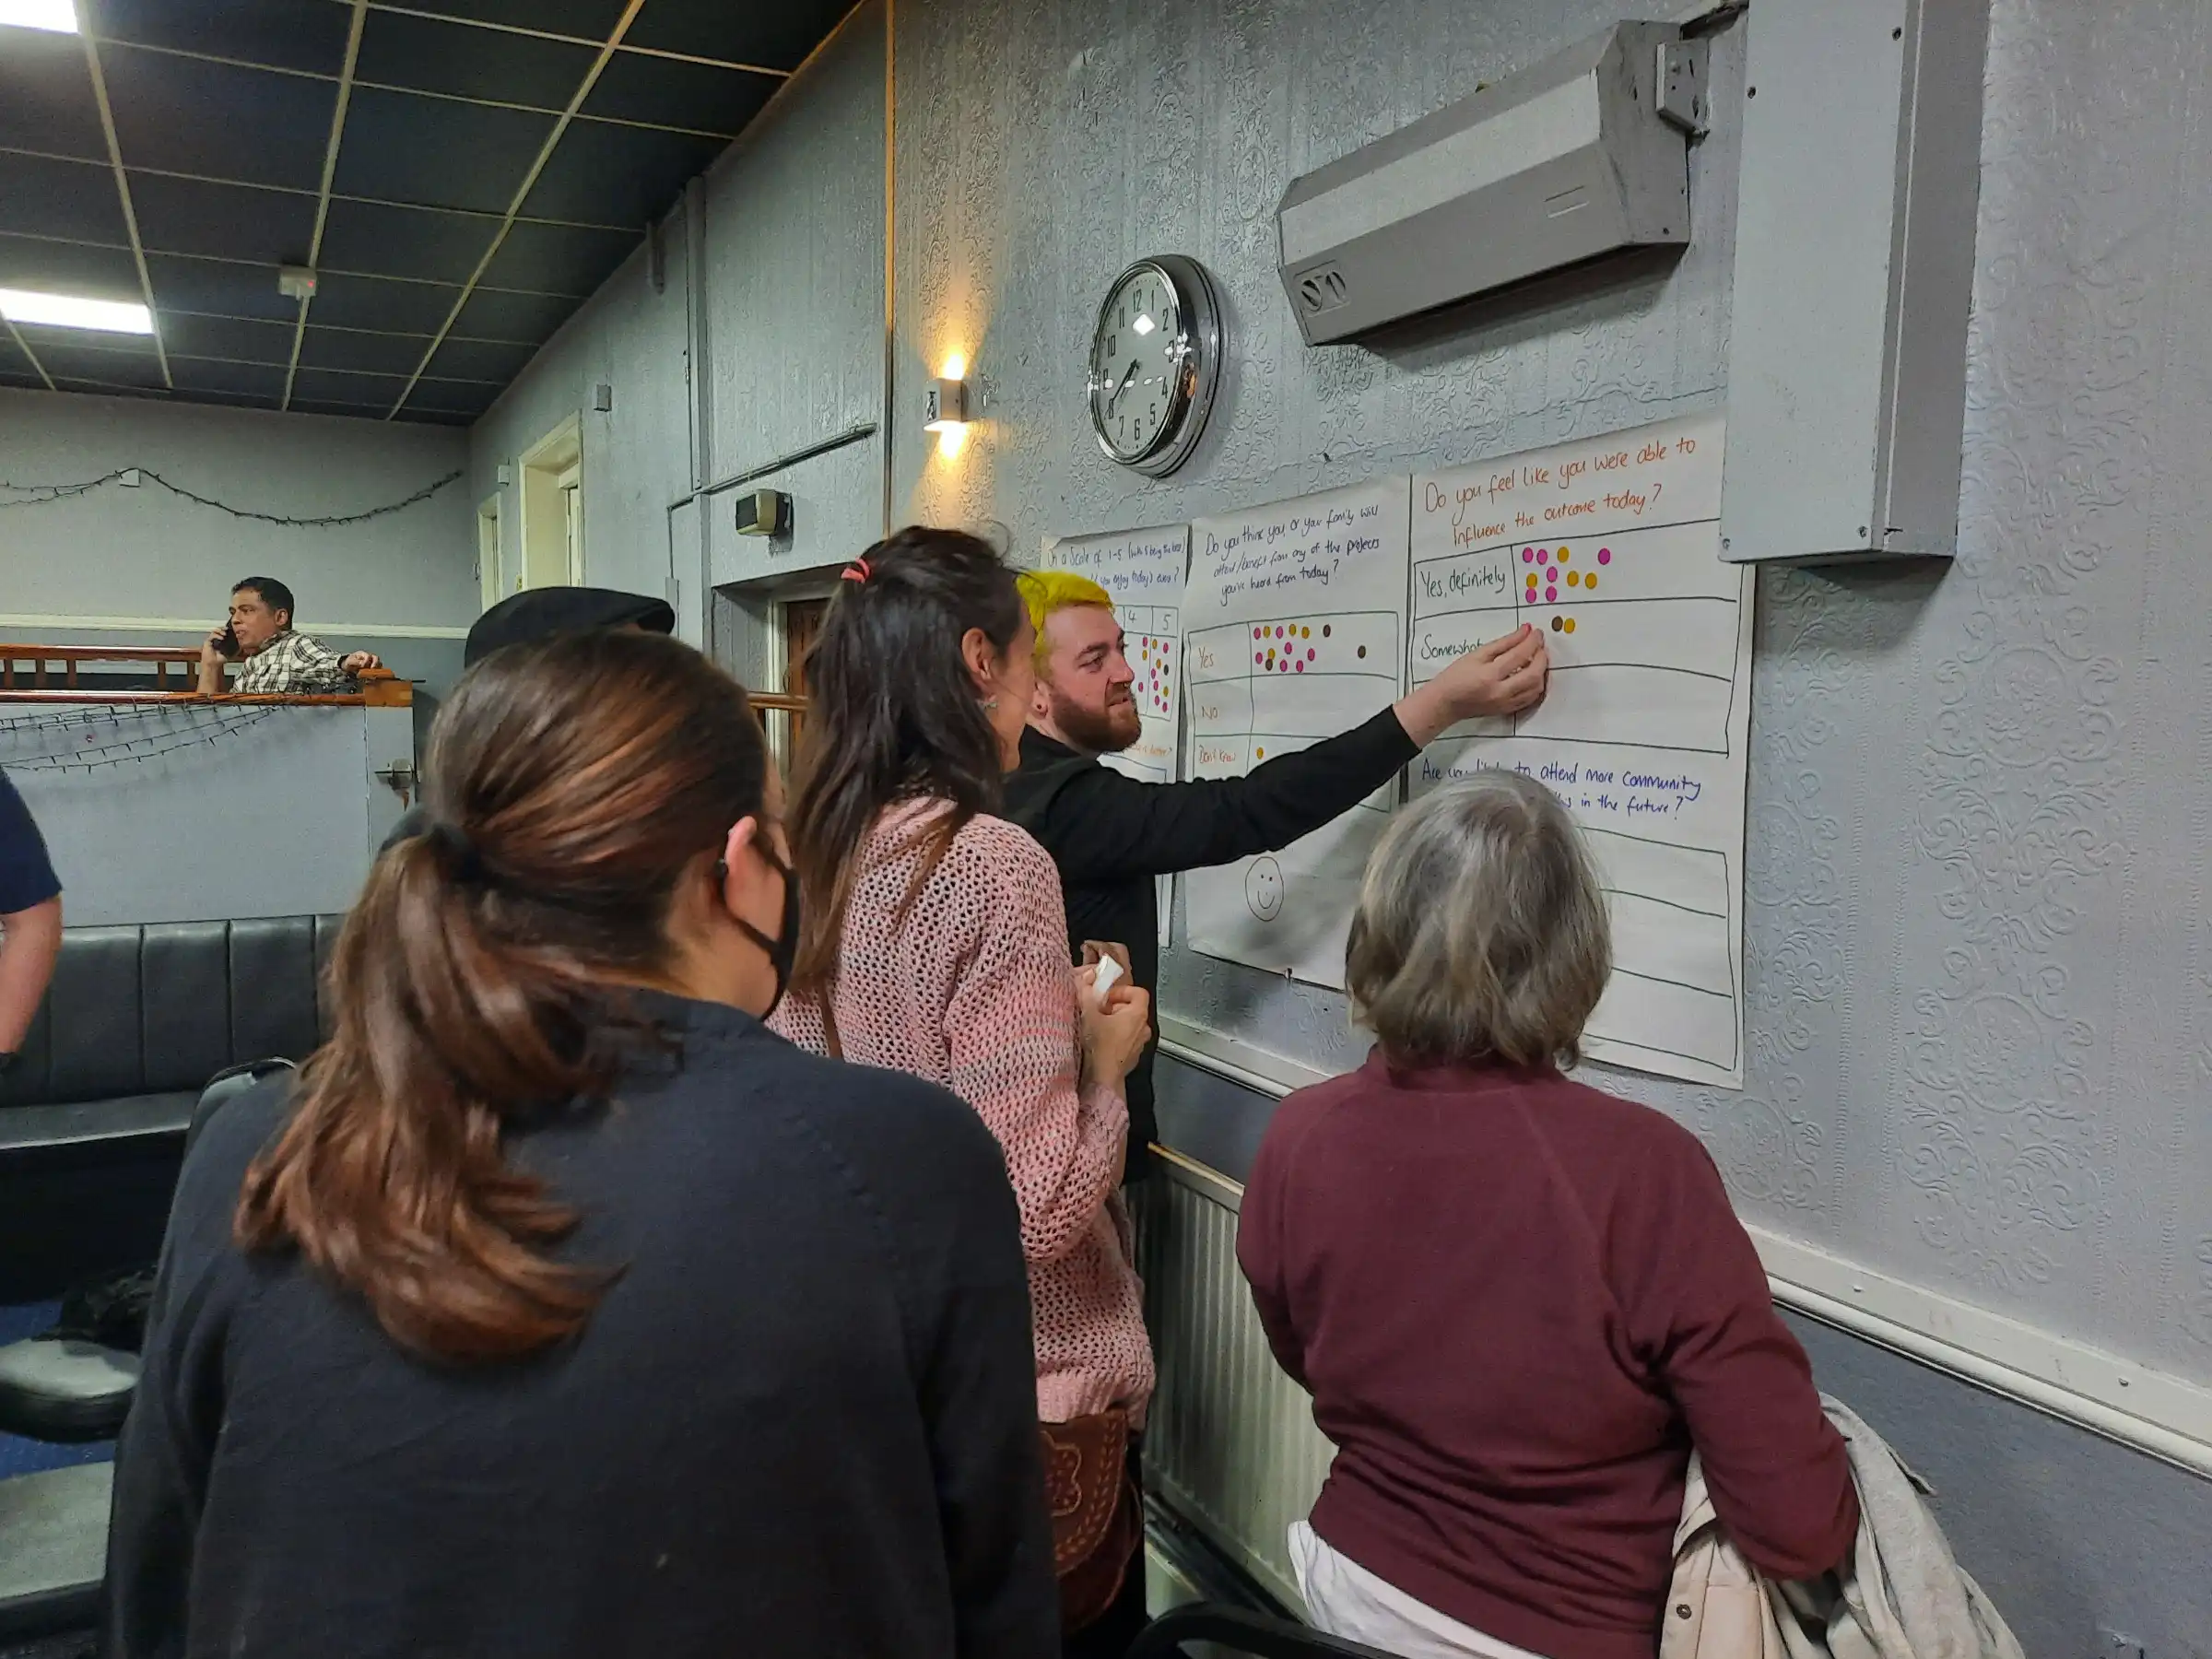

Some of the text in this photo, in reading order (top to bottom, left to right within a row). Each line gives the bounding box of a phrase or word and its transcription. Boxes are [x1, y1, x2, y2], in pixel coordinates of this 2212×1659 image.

[1133, 288, 1143, 312] 12
[1151, 288, 1155, 312] 1
[1118, 306, 1125, 329] 11
[1162, 308, 1169, 332] 2
[1107, 335, 1116, 358] 10
[1161, 376, 1168, 399] 4
[1108, 398, 1114, 420] 8
[1149, 402, 1156, 426] 5
[1118, 416, 1124, 438] 7
[1134, 418, 1141, 441] 6
[1425, 481, 1447, 512] Do
[1452, 484, 1482, 526] you
[1488, 468, 1515, 505] feel
[1523, 466, 1549, 487] like
[1558, 460, 1586, 489] you
[1637, 440, 1667, 465] able
[1676, 437, 1696, 454] to
[1453, 523, 1506, 548] Influence
[1514, 511, 1535, 528] the
[1544, 499, 1596, 521] outcome
[1206, 532, 1219, 556] Do
[1221, 536, 1240, 561] you
[1242, 524, 1264, 542] think
[1311, 542, 1320, 554] of
[1324, 539, 1341, 553] the
[1062, 553, 1066, 565] a
[1094, 548, 1102, 569] of
[1276, 572, 1297, 589] from
[1449, 565, 1506, 595] definitely
[1128, 610, 1136, 624] 4
[1162, 614, 1171, 631] 5
[1198, 647, 1215, 670] Yes
[1421, 757, 1442, 780] Are
[1540, 760, 1579, 783] attend
[1581, 792, 1591, 808] in
[1597, 794, 1618, 811] the
